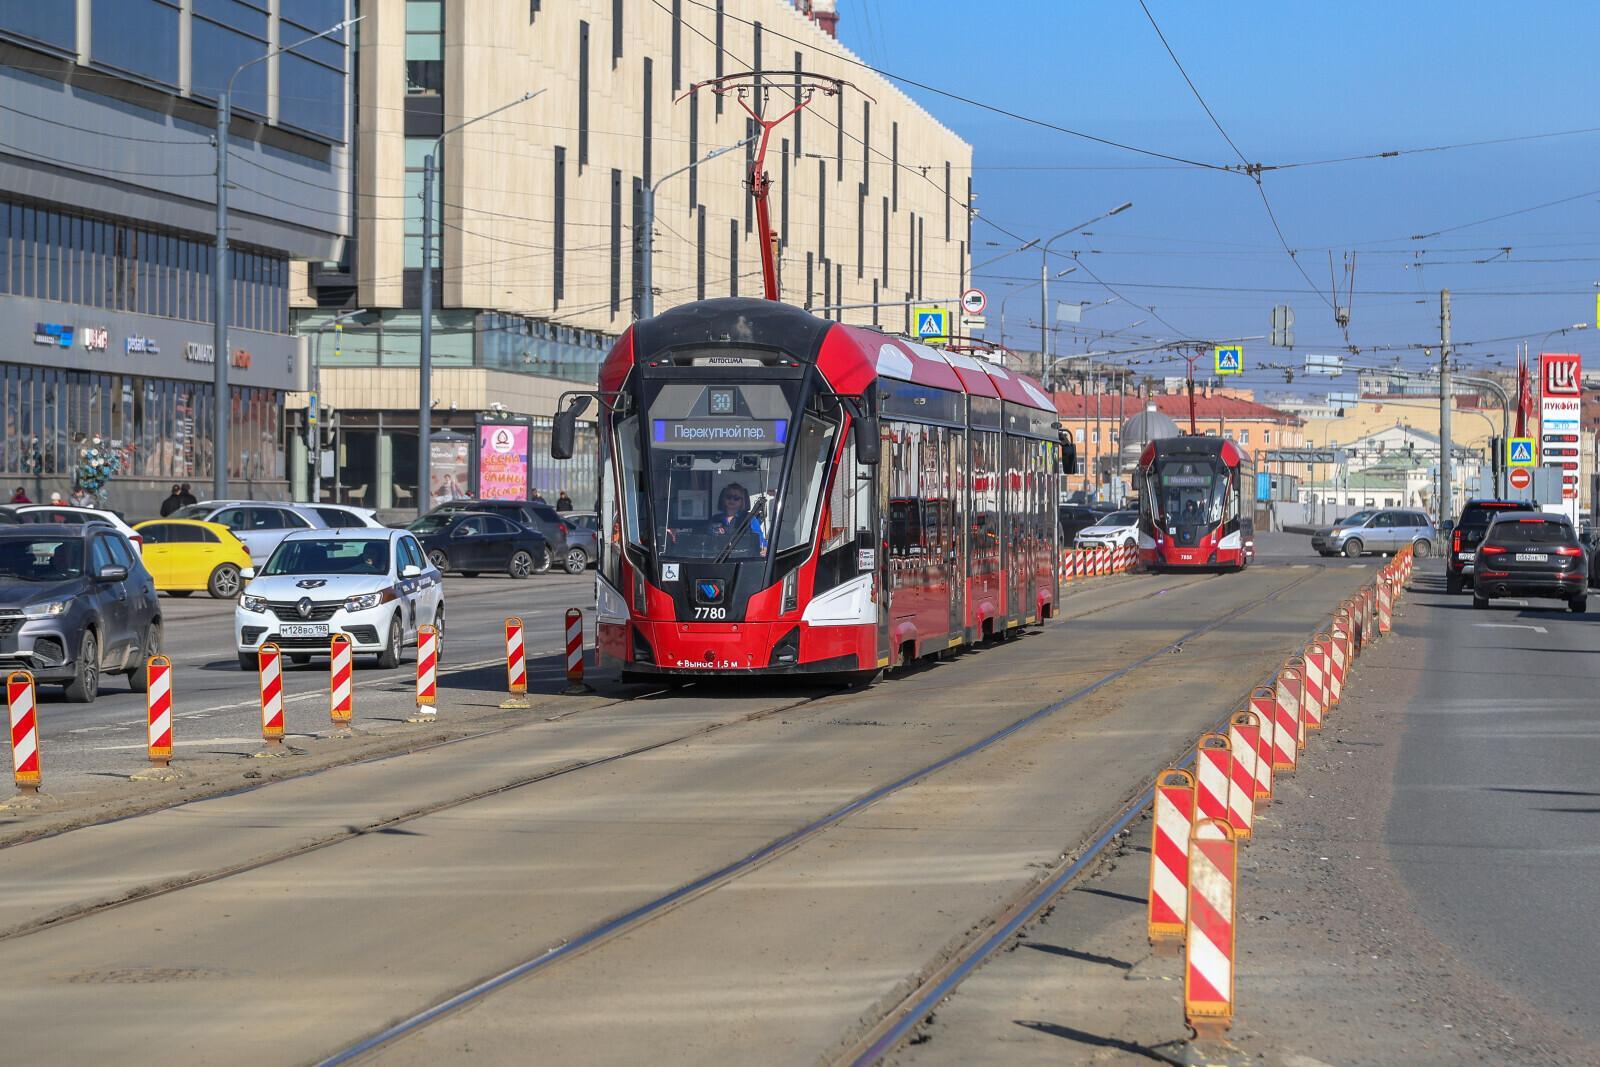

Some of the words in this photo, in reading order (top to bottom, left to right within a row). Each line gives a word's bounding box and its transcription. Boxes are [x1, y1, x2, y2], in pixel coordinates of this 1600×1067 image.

[127, 333, 145, 354] pedant
[712, 394, 730, 410] 30
[1544, 402, 1578, 411] ЛУКОЙЛ
[674, 424, 741, 440] Перекупной
[743, 428, 766, 440] пер.
[694, 607, 726, 620] 7780
[684, 660, 714, 668] Вынос
[717, 660, 729, 668] 1,5
